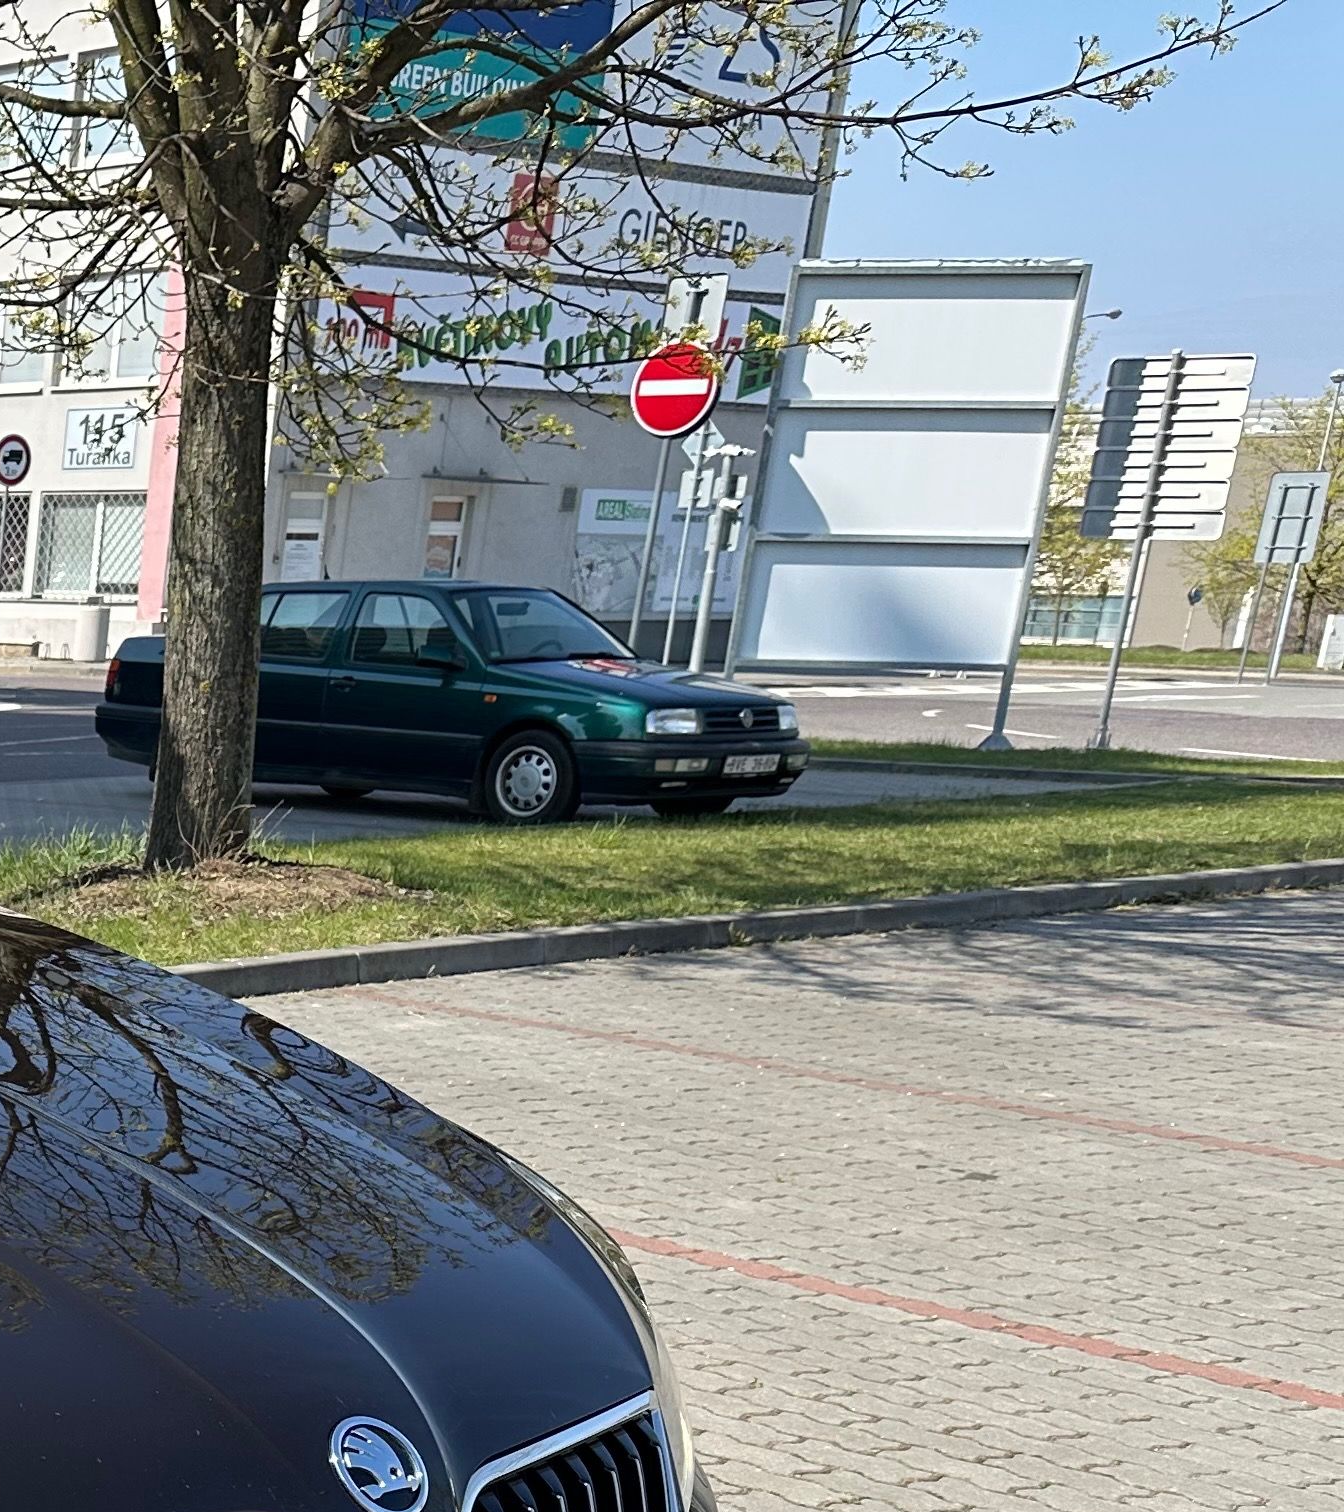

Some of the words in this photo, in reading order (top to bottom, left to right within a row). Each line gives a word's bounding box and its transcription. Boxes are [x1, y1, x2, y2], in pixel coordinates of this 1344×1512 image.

[450, 70, 534, 99] BUILDI
[543, 317, 662, 380] AUTOM
[79, 413, 125, 445] 115
